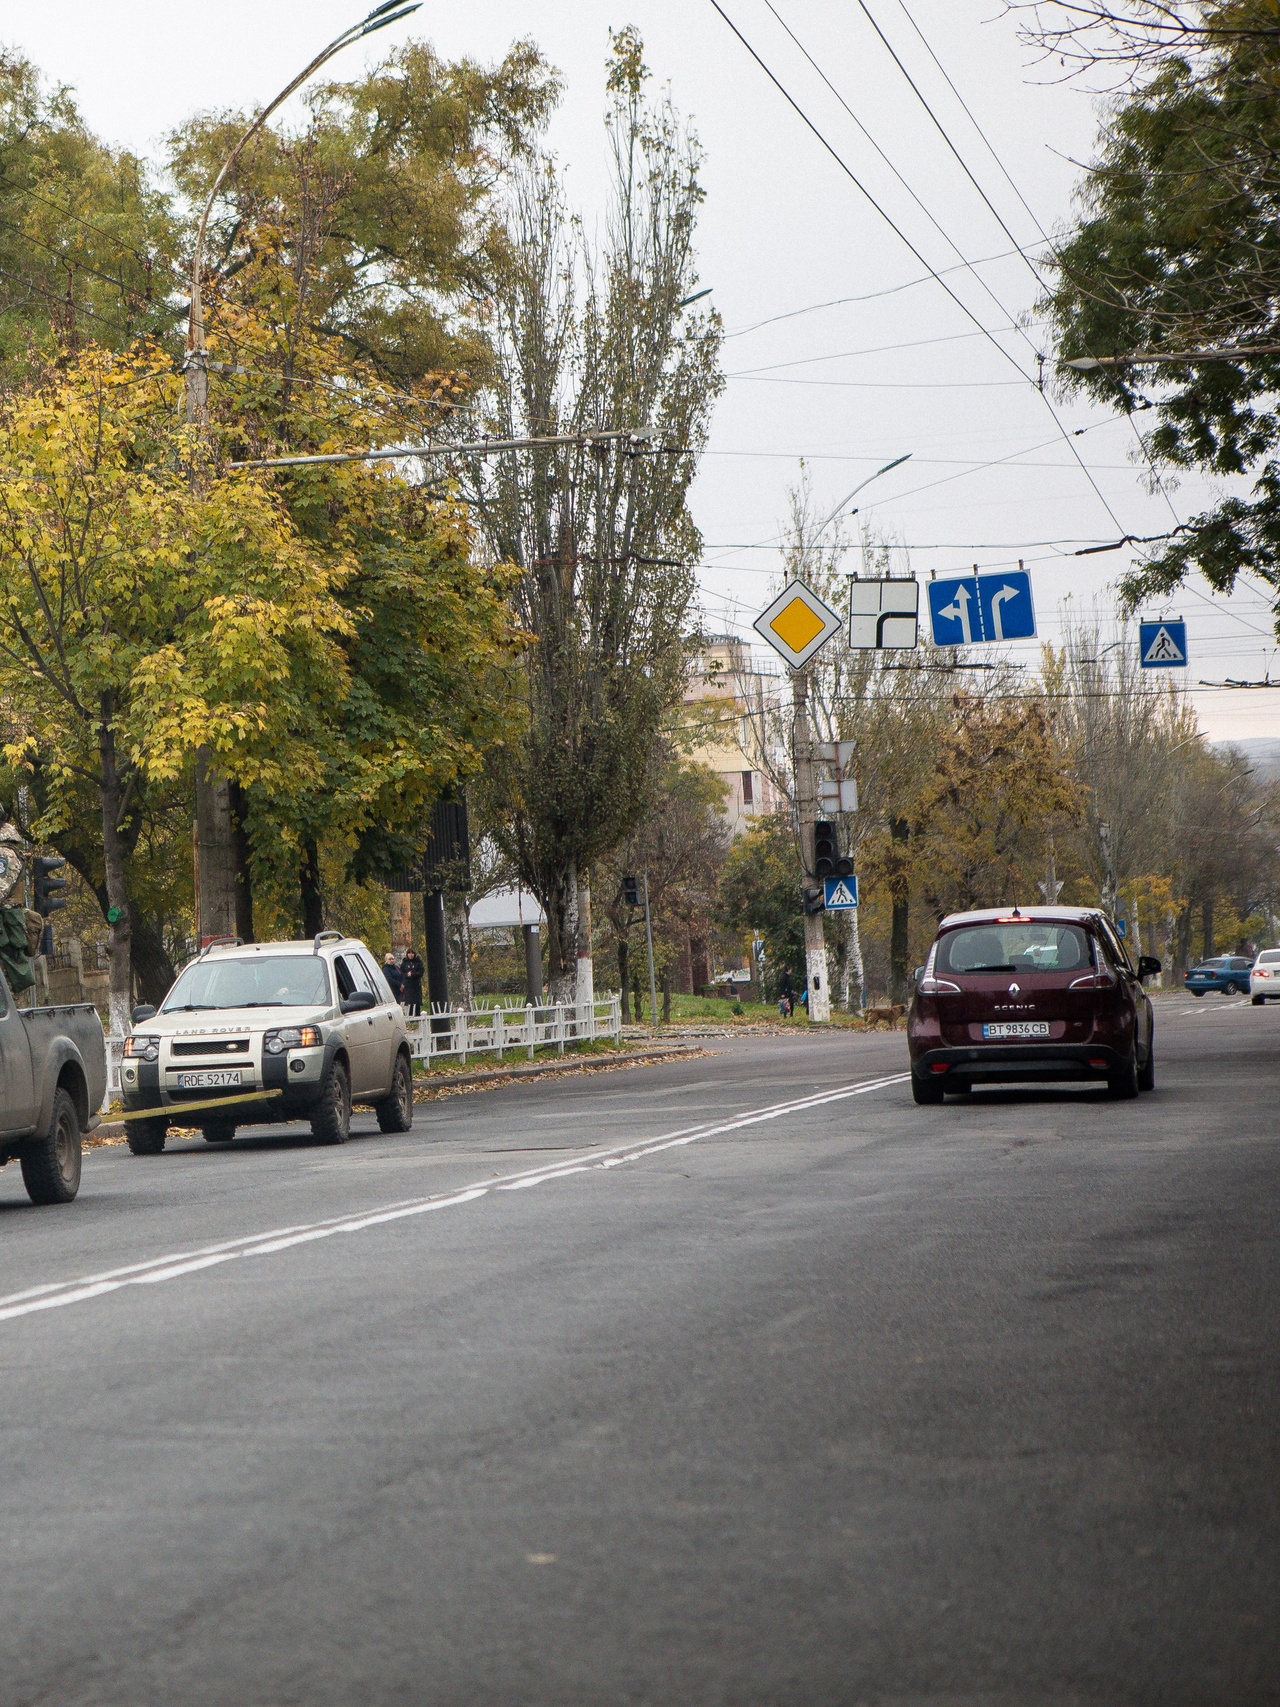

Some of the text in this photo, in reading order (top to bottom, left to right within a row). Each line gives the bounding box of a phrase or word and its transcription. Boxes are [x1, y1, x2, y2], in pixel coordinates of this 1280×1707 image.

[989, 1023, 1048, 1035] BT 9836 CB
[184, 1072, 240, 1087] RDE 52174
